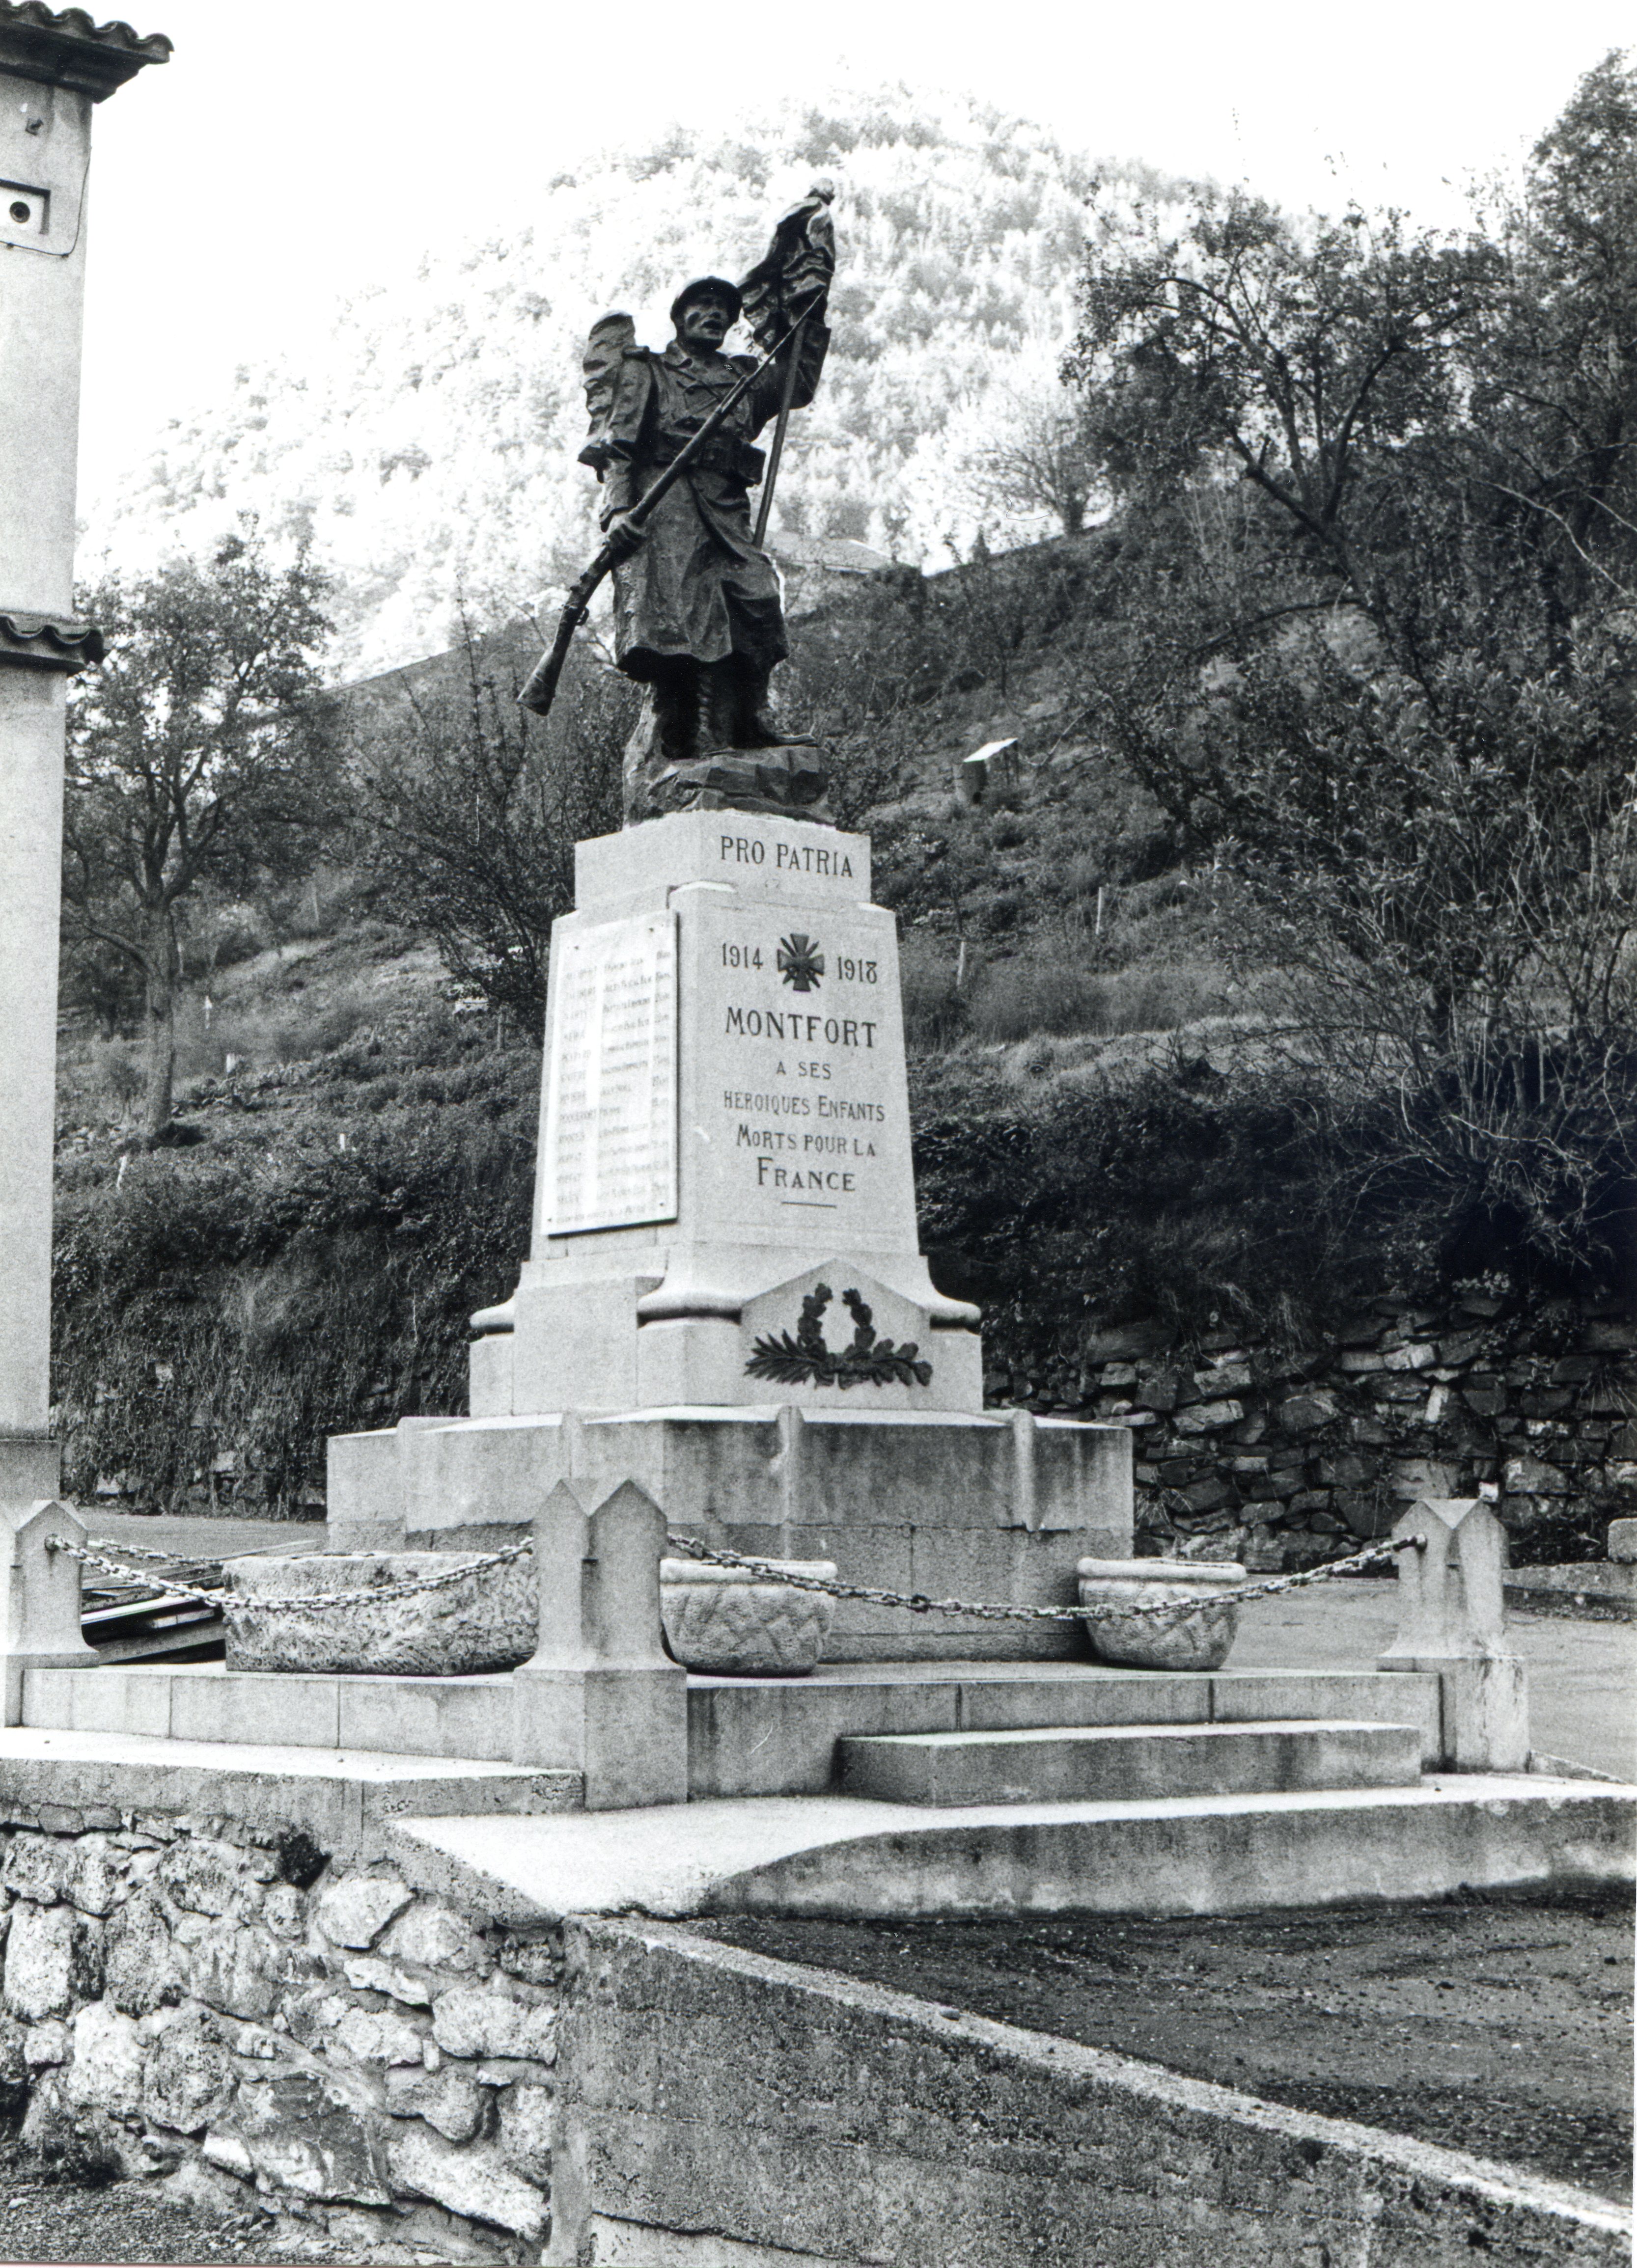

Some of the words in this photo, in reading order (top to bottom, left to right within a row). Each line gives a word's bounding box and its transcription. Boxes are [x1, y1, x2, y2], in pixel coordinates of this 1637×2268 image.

[721, 836, 765, 865] PRO
[776, 843, 853, 877] PATRIA
[722, 943, 763, 970] 1914
[837, 956, 877, 984] 1918
[725, 1006, 877, 1048] MONTFORT
[776, 1061, 786, 1075] A
[798, 1061, 832, 1080] SES
[818, 1095, 885, 1121] ENFANTS
[736, 1124, 797, 1150] MORTS
[804, 1134, 847, 1154] POUR
[854, 1138, 876, 1157] LA
[757, 1156, 856, 1192] FRANCE
